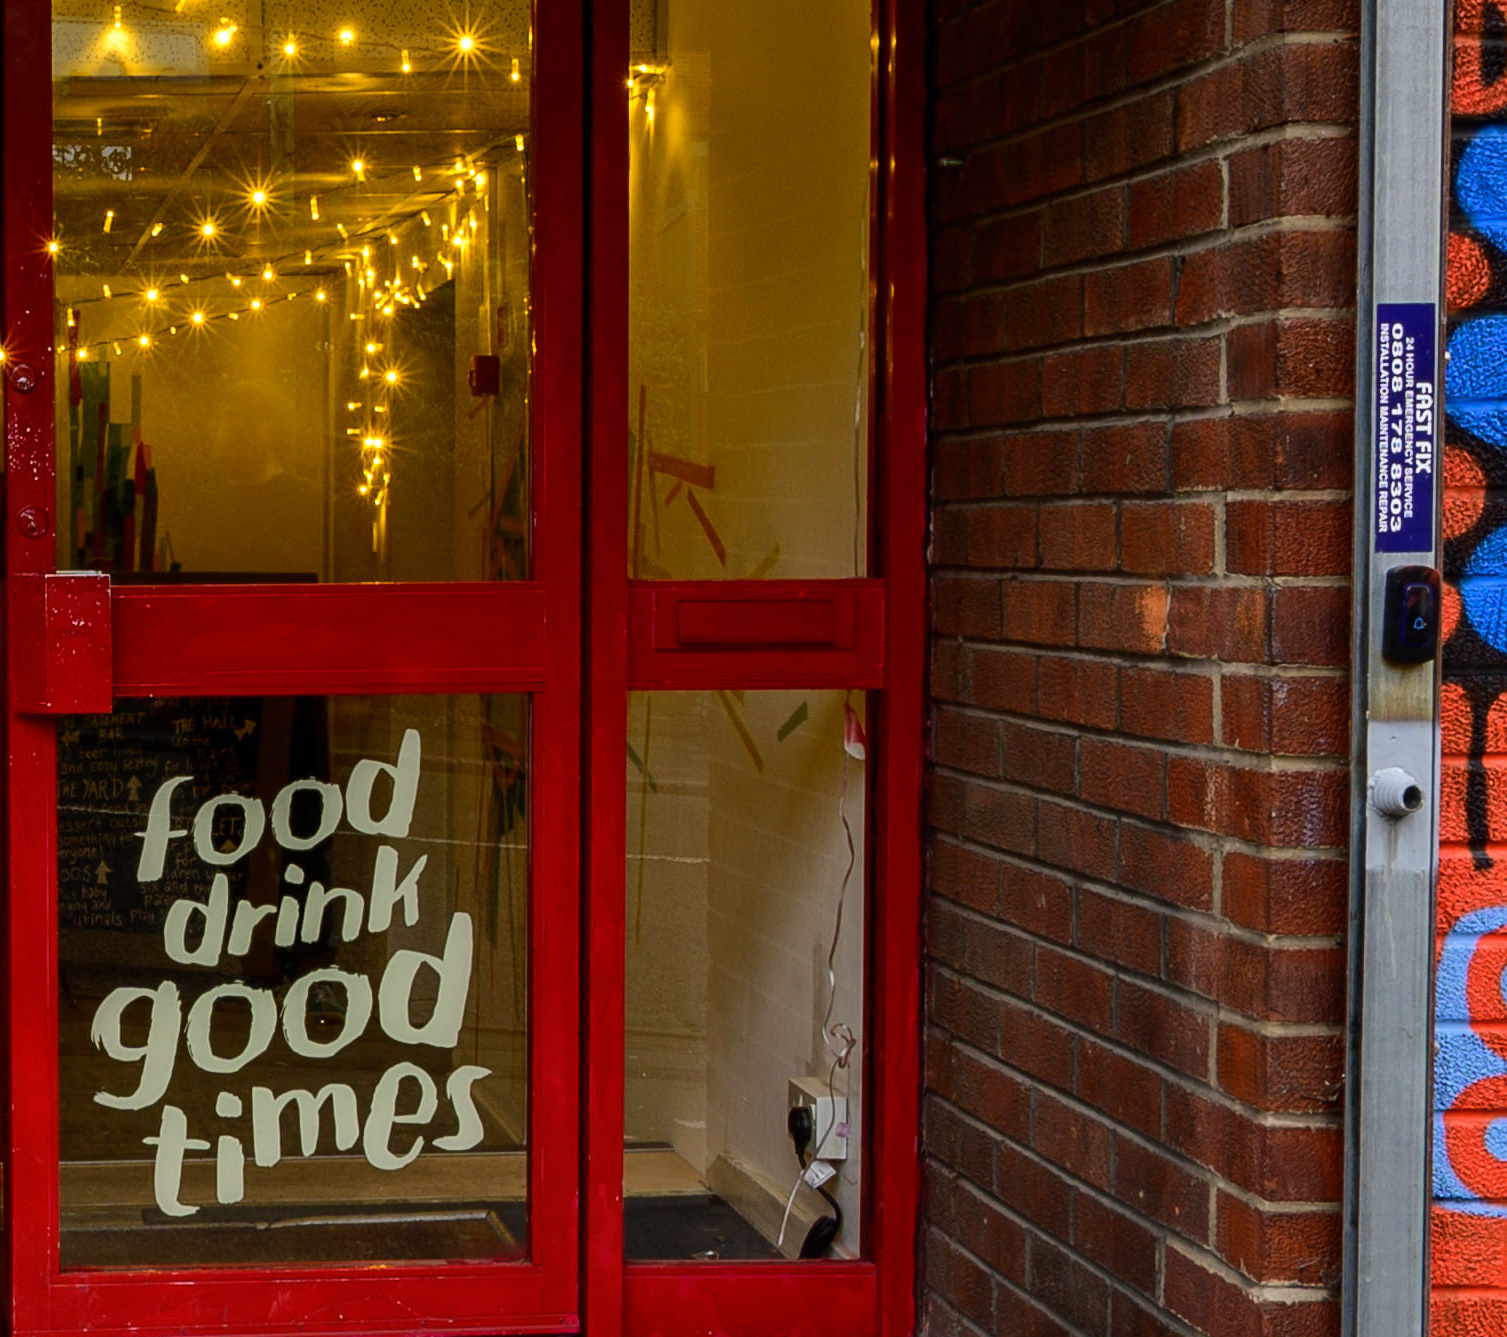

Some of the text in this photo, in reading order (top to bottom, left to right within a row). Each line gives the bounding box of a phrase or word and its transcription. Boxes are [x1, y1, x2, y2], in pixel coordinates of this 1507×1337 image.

[1378, 323, 1389, 533] INSTALLATION MAINTENANCE REPAIR
[1390, 322, 1404, 532] 0808 178 8303
[1403, 336, 1415, 518] 24 HOUR EMERGENCY SERVICE
[1415, 382, 1432, 474] FAST FIX
[82, 777, 125, 801] YARD
[201, 714, 238, 729] HALL
[57, 841, 105, 864] eryone!
[60, 864, 92, 883] OOS
[135, 729, 421, 883] food
[164, 846, 428, 967] drink
[91, 912, 474, 1111] good
[143, 1062, 493, 1218] times
